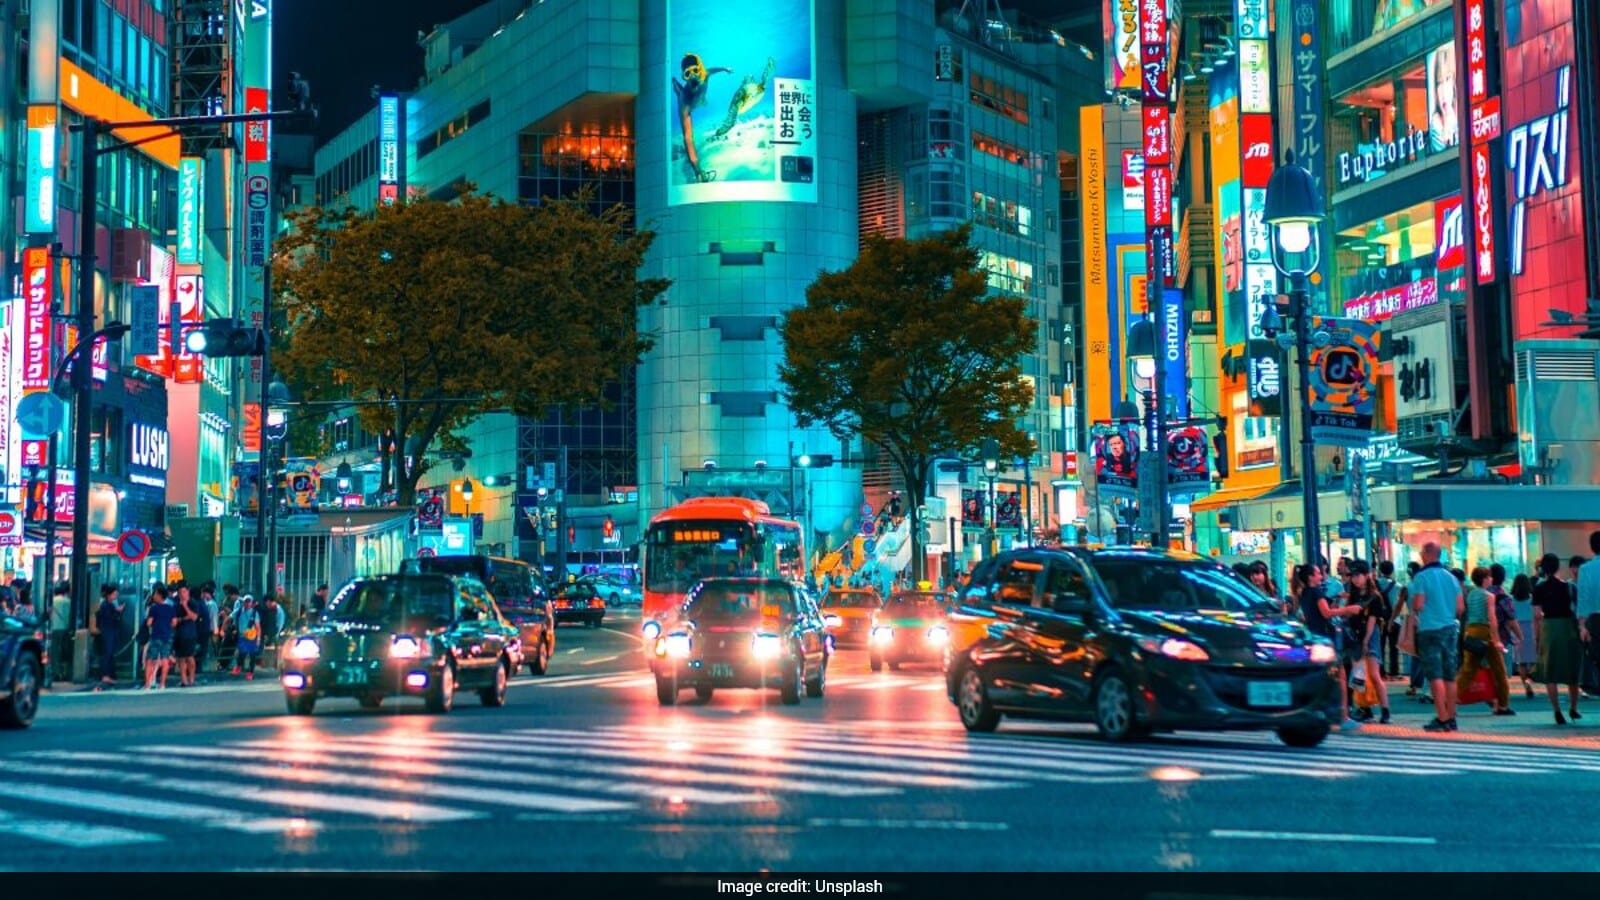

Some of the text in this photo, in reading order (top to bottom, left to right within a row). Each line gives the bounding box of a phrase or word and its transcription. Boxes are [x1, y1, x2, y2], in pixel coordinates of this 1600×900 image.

[1296, 50, 1321, 188] サマーフルー
[1245, 143, 1270, 158] JTB
[1340, 126, 1426, 183] Euphoria
[1508, 108, 1572, 198] クスリ
[1438, 203, 1463, 259] JT
[28, 287, 46, 378] サンドラッグ
[1165, 304, 1179, 361] MIZUHO
[1257, 357, 1280, 397] HUB
[131, 423, 168, 471] LUSH
